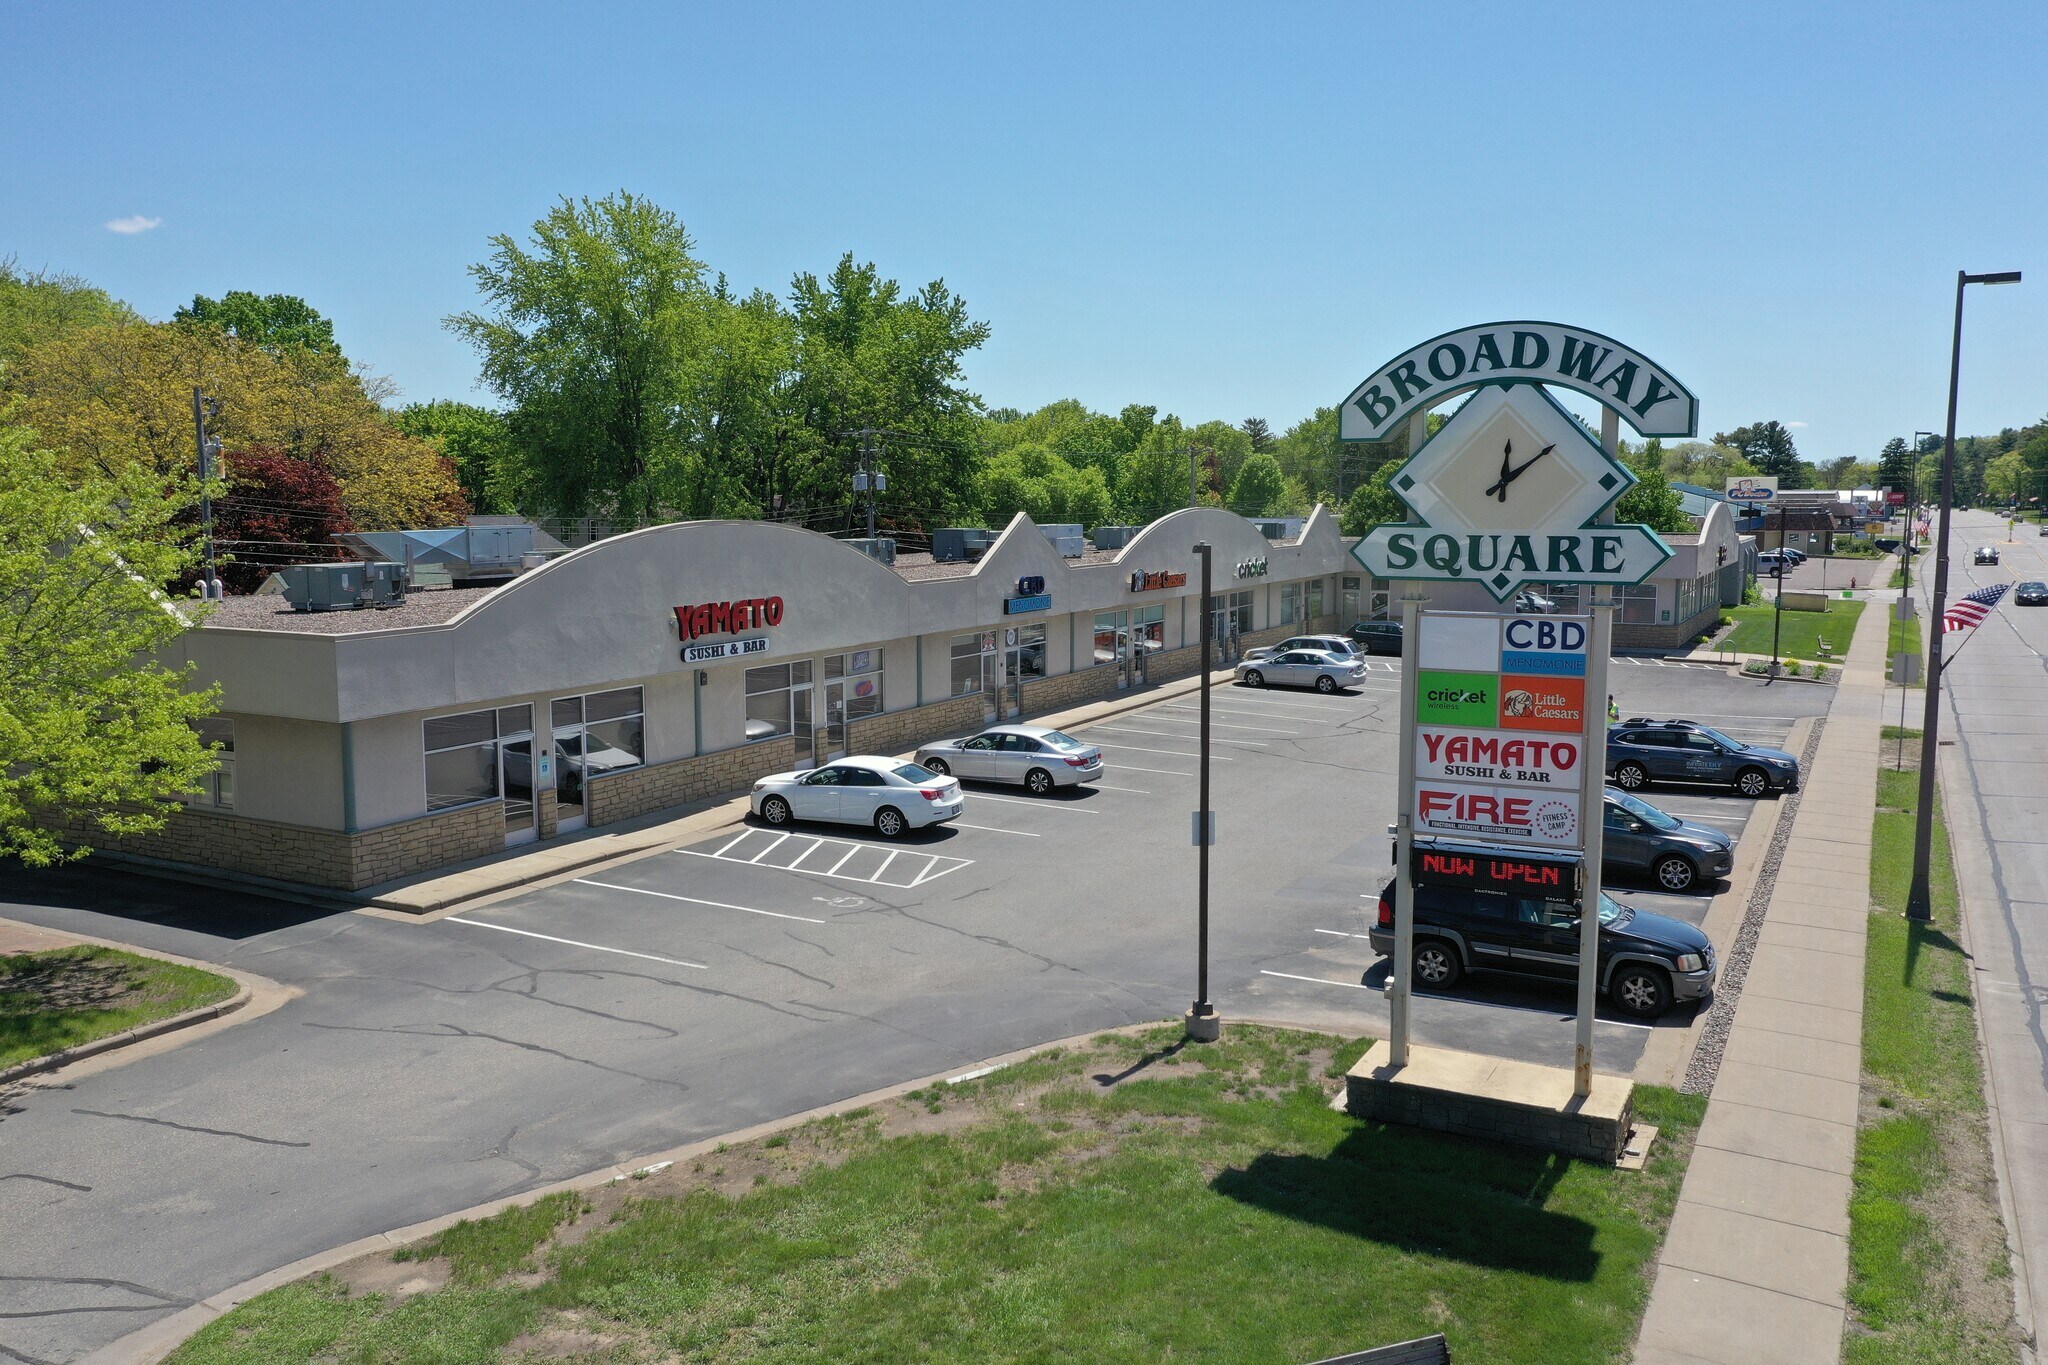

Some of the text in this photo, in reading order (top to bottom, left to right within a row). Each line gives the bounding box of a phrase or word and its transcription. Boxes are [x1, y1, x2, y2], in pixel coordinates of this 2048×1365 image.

[1353, 331, 1679, 429] BROADWAY
[1386, 533, 1626, 577] SQUARE
[1238, 556, 1269, 579] cricket
[1019, 575, 1045, 595] CBD
[1145, 570, 1186, 590] Little Caesars
[673, 596, 784, 641] YAMATO
[1506, 619, 1585, 650] CBD
[689, 639, 766, 661] SUSHI & BAR
[1506, 658, 1583, 670] MENOMONIE
[1427, 688, 1487, 704] cricket
[1427, 702, 1459, 710] wireless
[1534, 692, 1566, 706] Little
[1534, 705, 1579, 720] Caesars
[1422, 733, 1577, 771] YAMATO
[1444, 765, 1551, 783] SUSHI & BAR
[1542, 813, 1568, 822] FITNESS
[1547, 821, 1566, 831] CAMP
[1423, 854, 1559, 885] NOW OPEN
